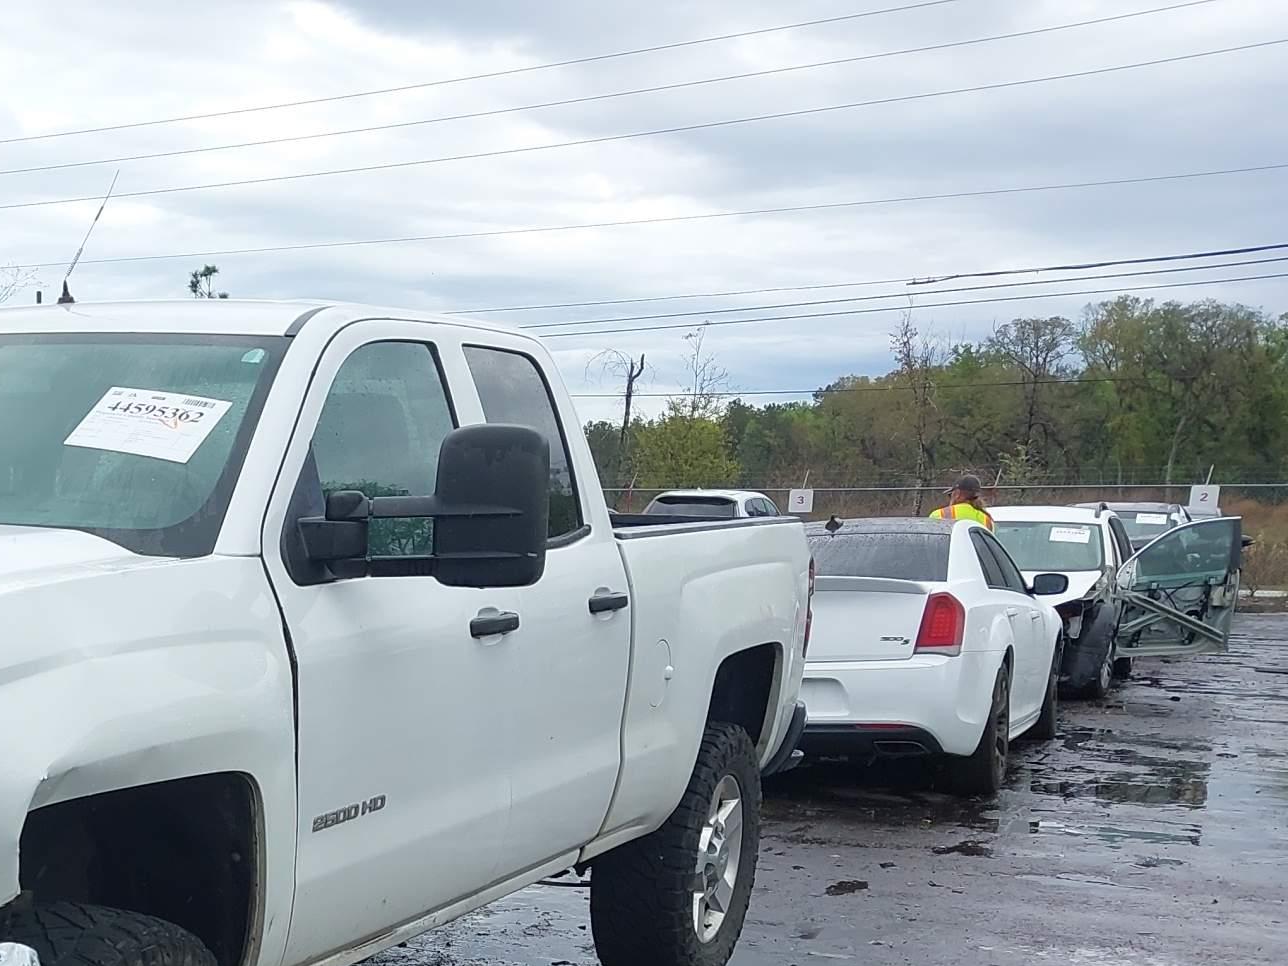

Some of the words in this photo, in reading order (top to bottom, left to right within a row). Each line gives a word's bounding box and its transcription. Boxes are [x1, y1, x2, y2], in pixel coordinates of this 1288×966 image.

[107, 401, 205, 424] 44595362
[796, 495, 805, 505] 3
[1199, 492, 1209, 502] 2
[312, 803, 360, 833] 2500
[361, 794, 386, 816] HD
